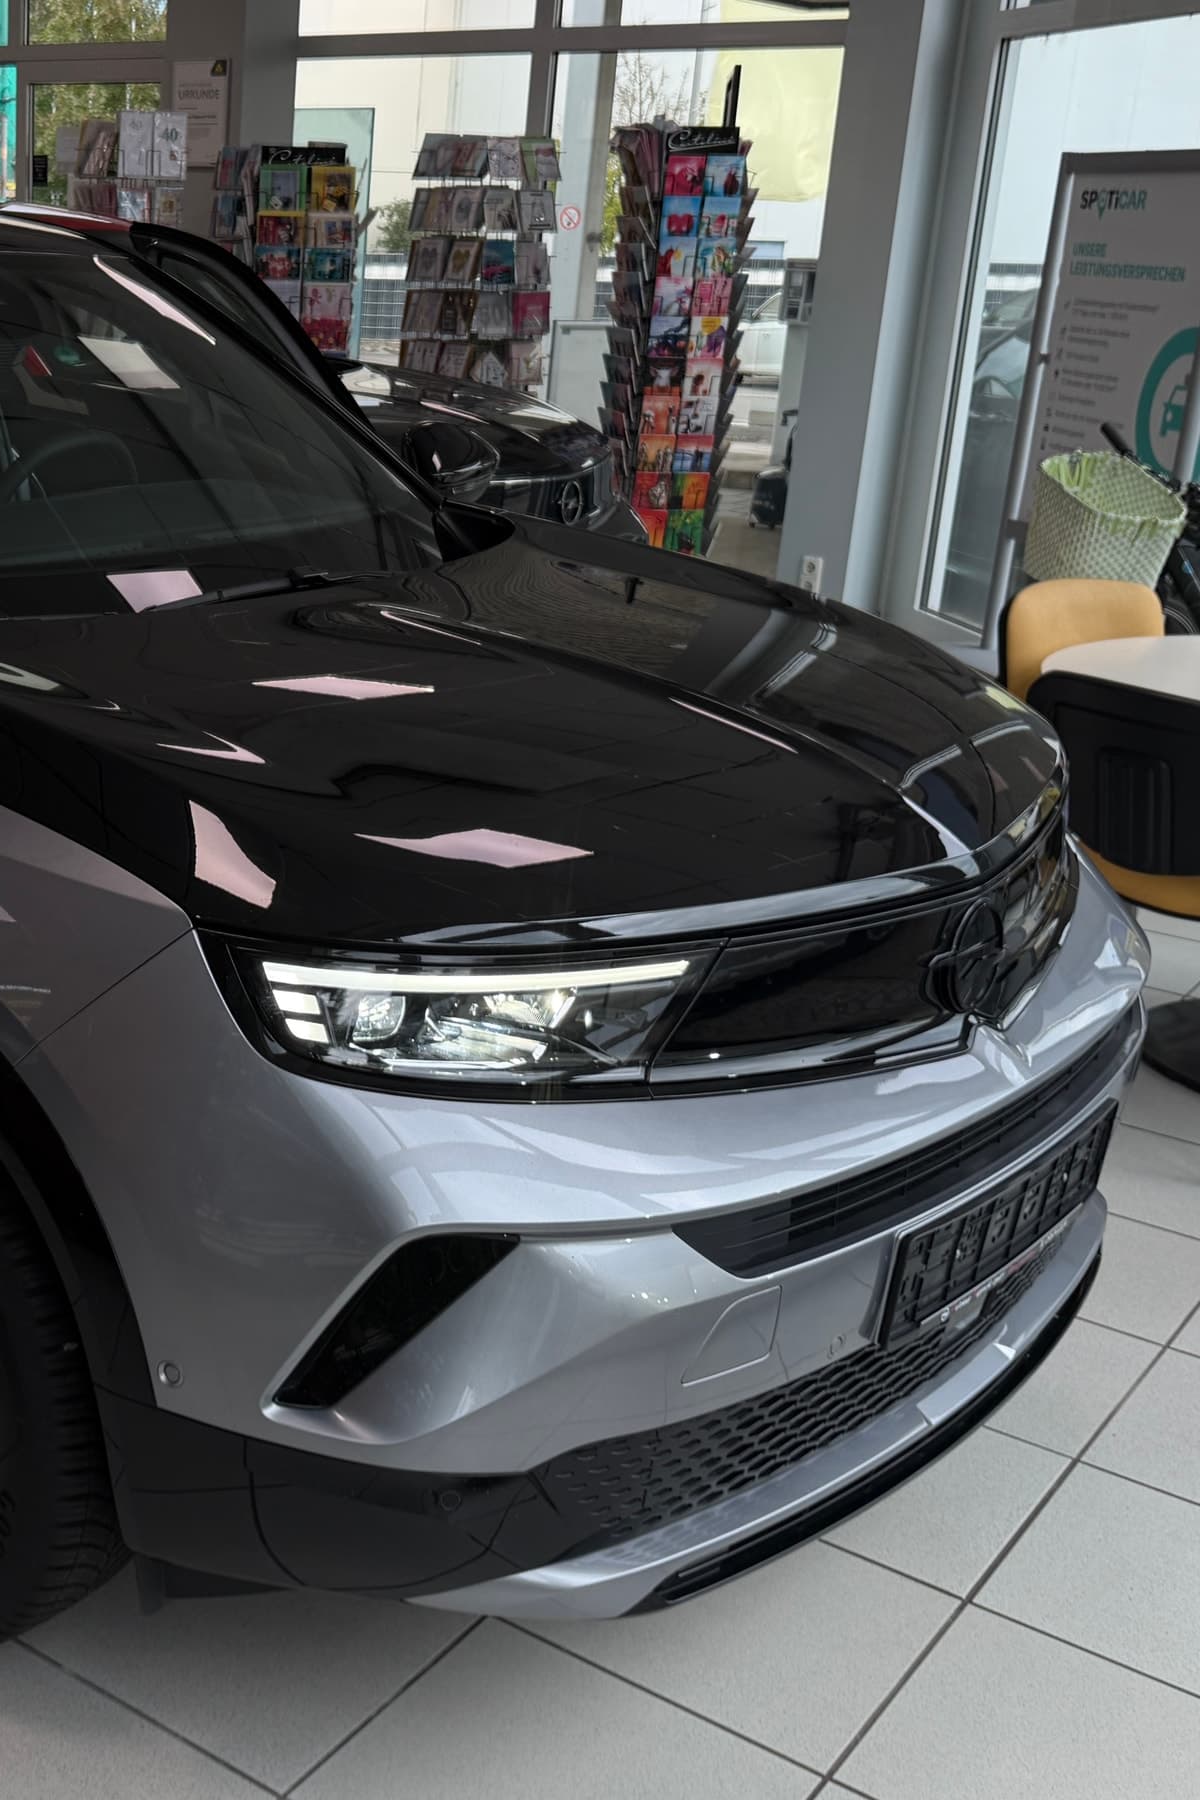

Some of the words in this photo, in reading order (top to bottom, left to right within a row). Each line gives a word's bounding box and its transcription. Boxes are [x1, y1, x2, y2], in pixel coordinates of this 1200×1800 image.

[178, 89, 220, 100] URKUNDE
[1072, 243, 1107, 258] UNSERE
[1070, 262, 1186, 282] LEISTUNGSVERSPRECHEN
